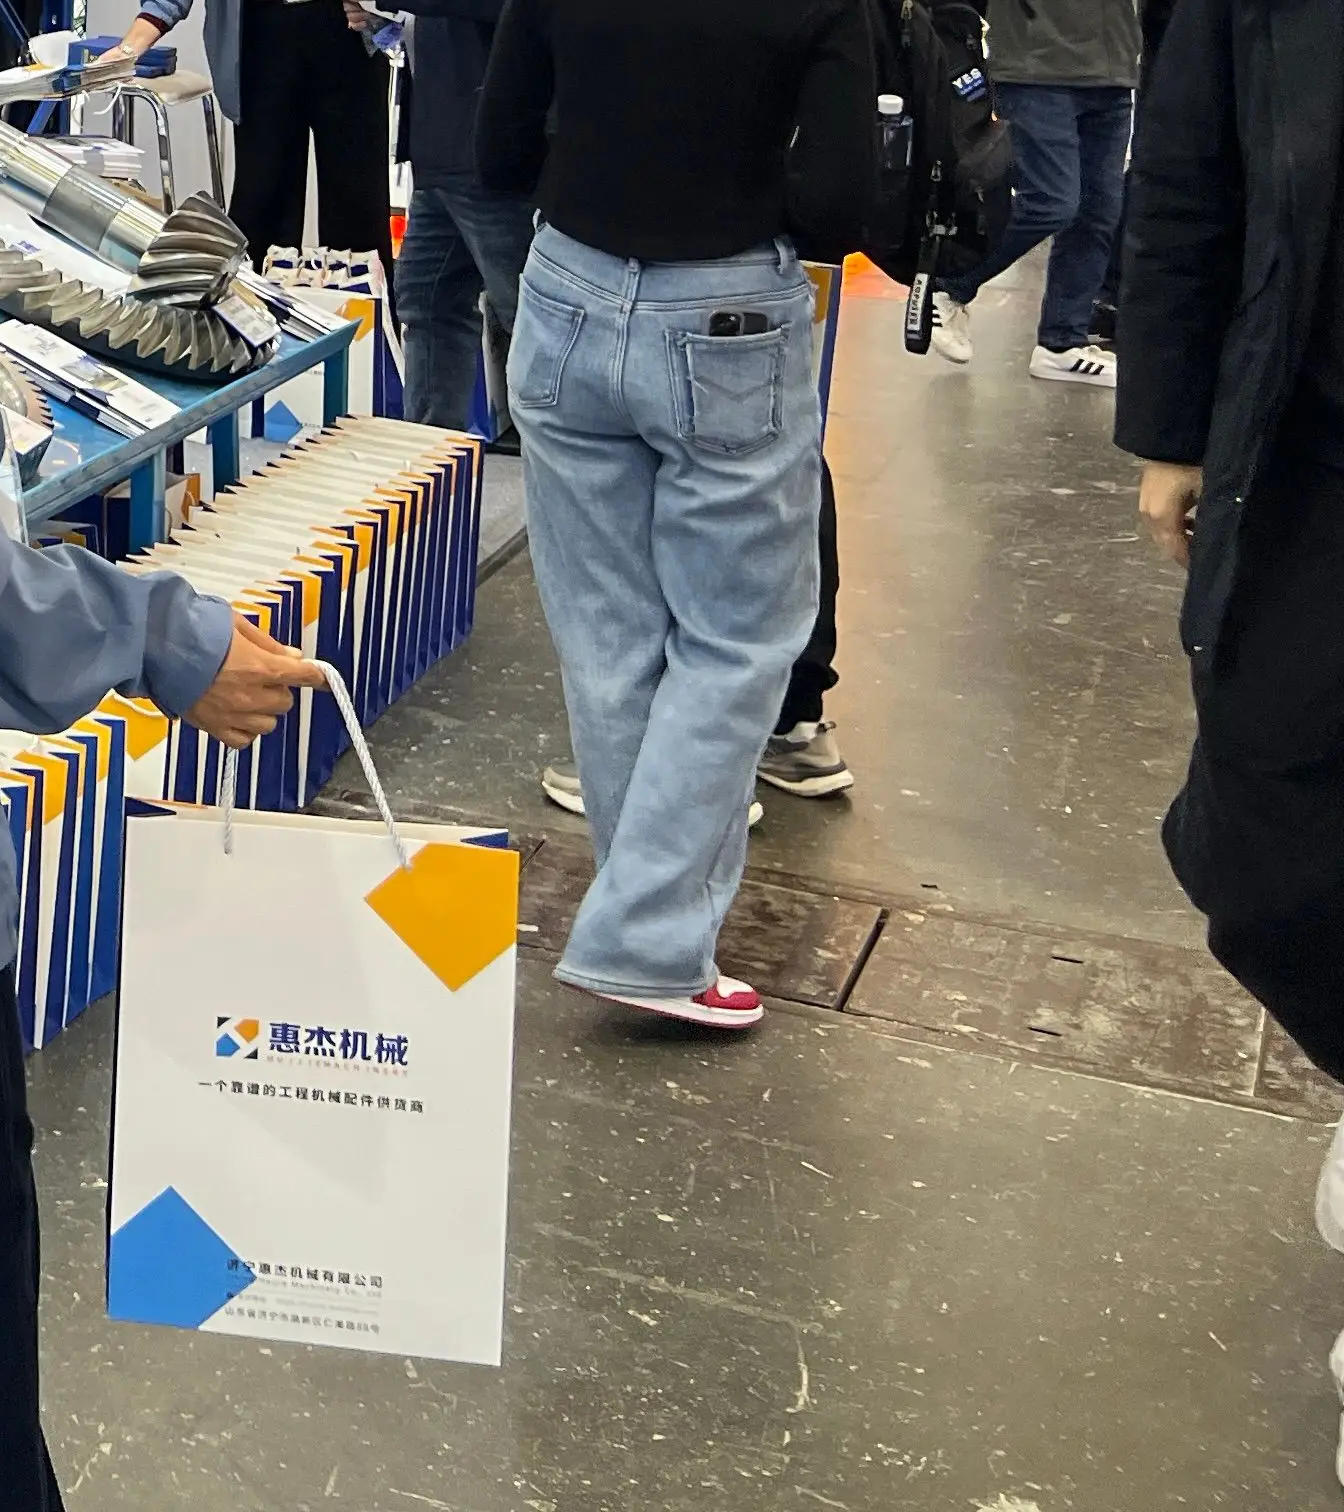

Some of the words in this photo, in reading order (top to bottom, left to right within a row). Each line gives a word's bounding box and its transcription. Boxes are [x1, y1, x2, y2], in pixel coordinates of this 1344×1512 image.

[268, 1021, 410, 1067] 惠杰机械
[197, 1079, 426, 1114] 一个靠谱的工程机械配件供货商
